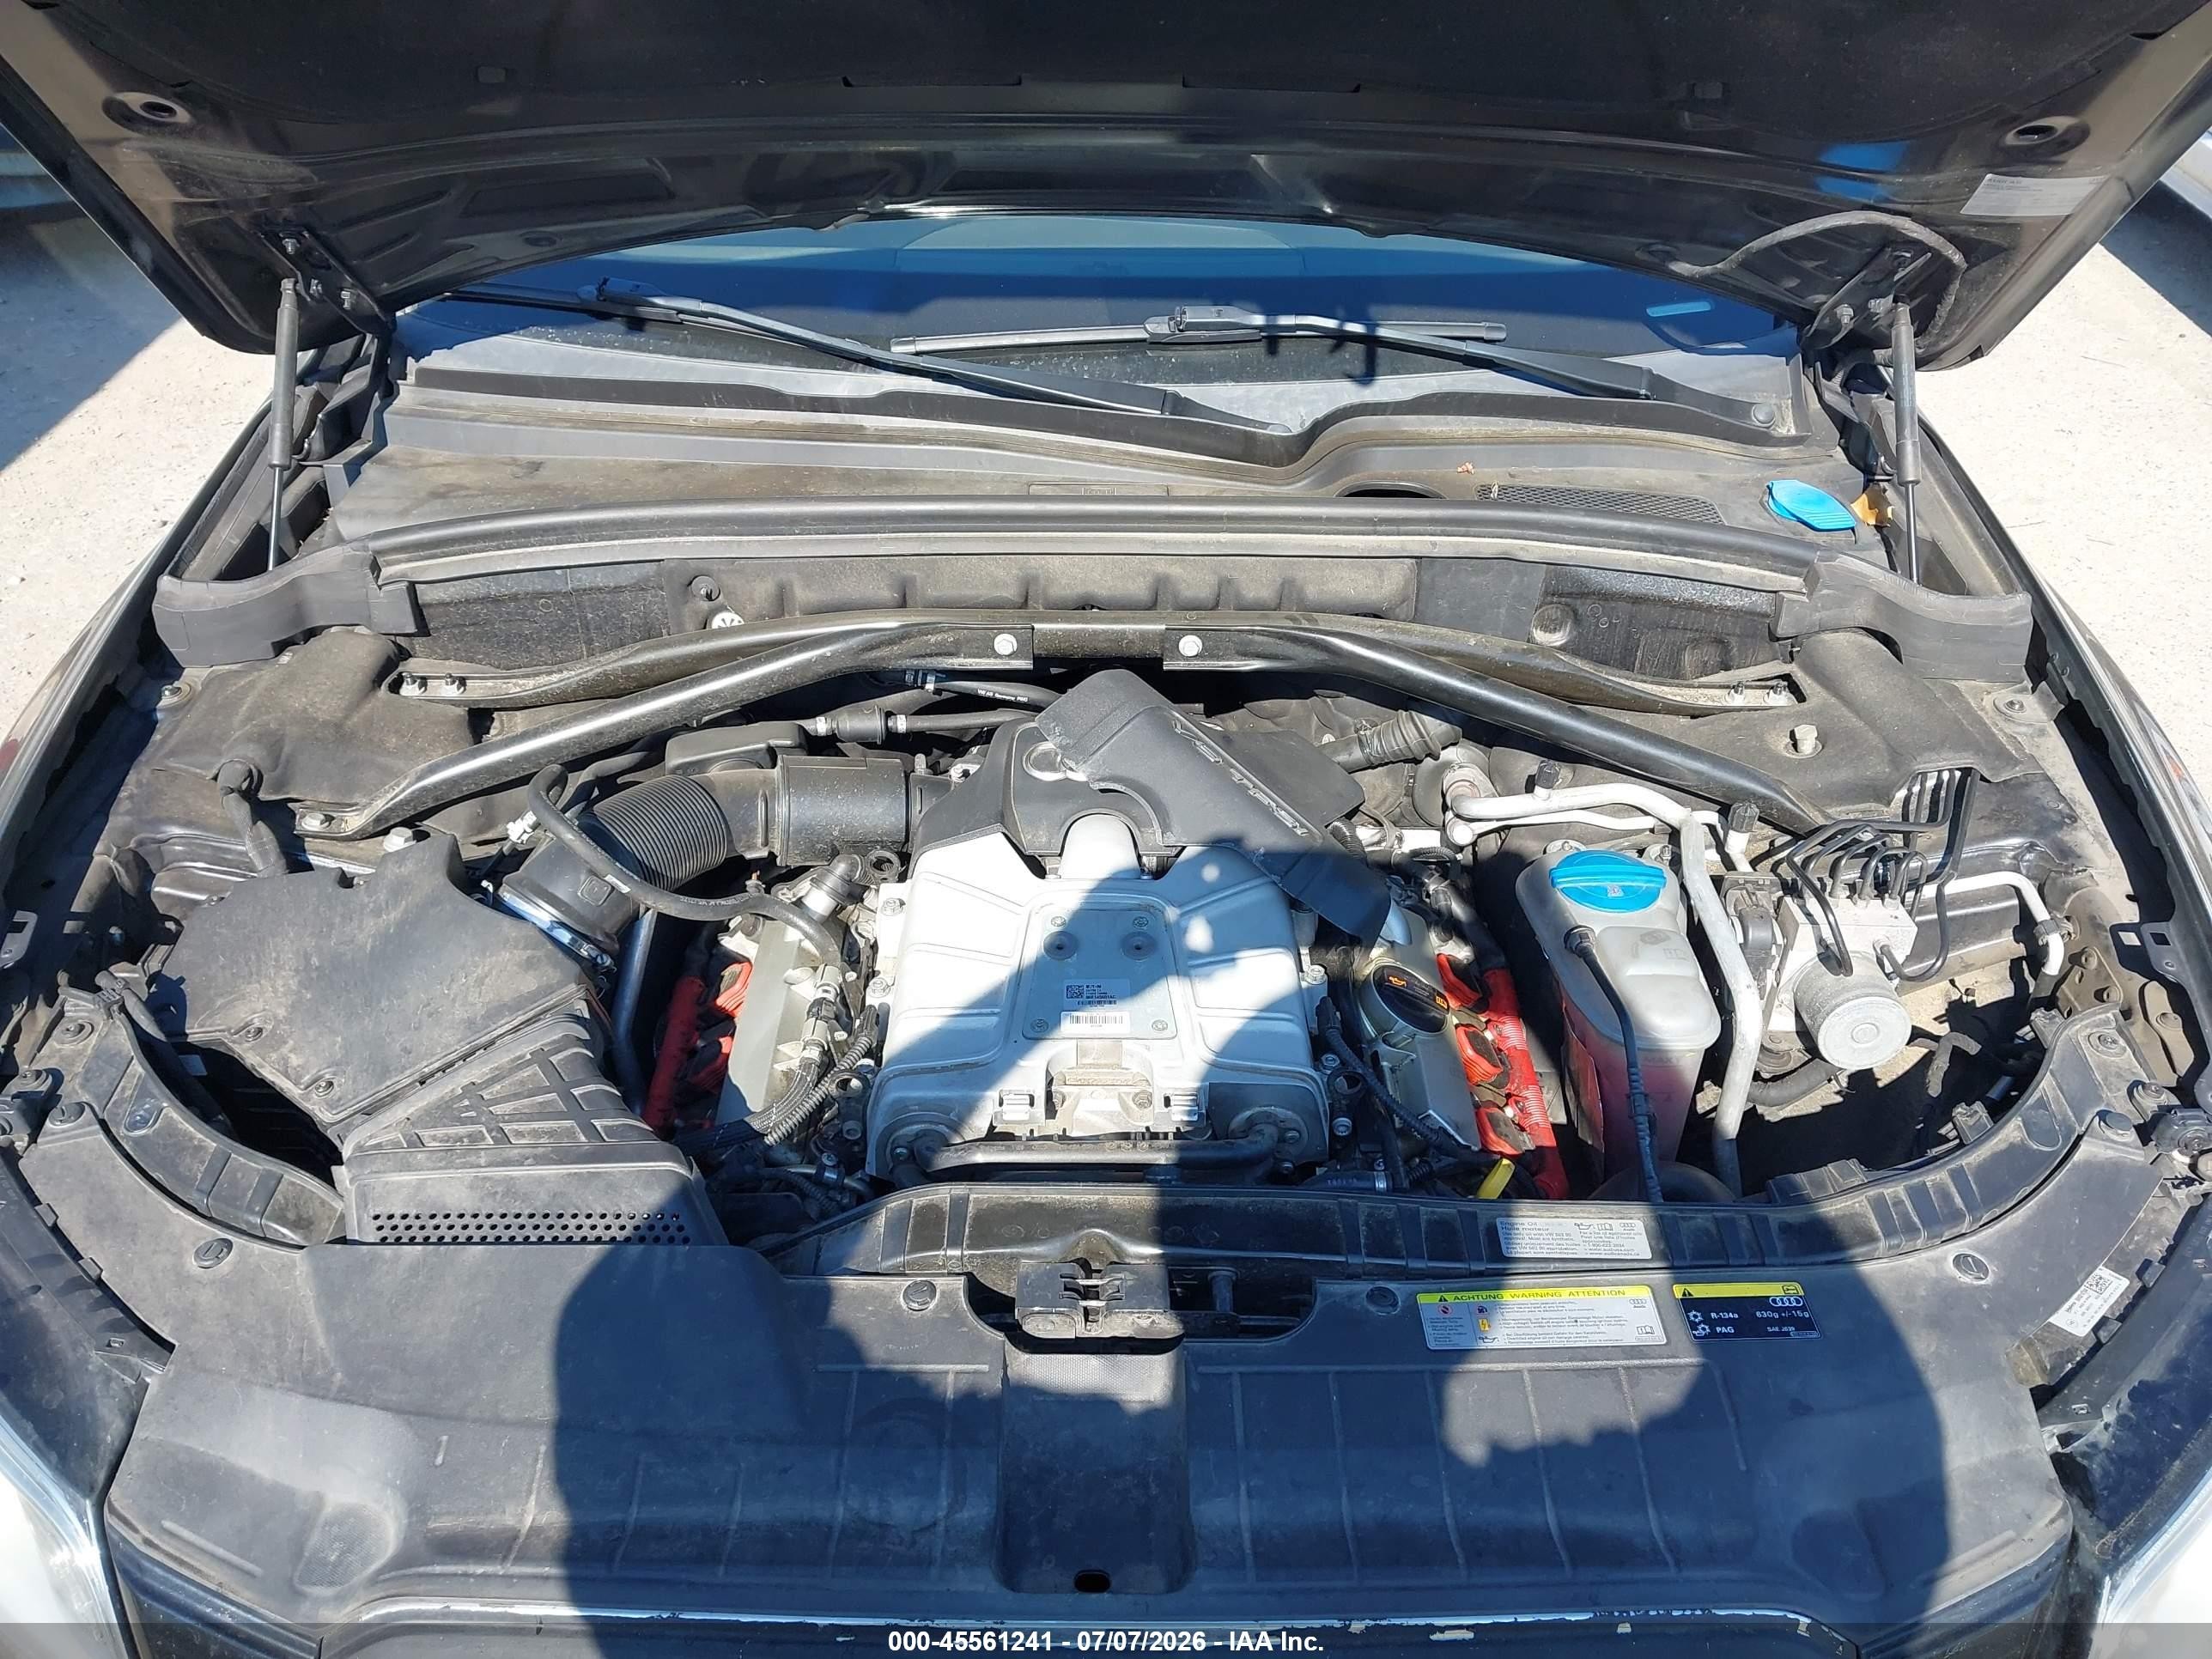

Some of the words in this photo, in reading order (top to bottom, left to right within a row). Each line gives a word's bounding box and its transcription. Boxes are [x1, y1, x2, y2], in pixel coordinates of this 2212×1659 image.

[1453, 1293, 1504, 1302] ACHTUNG
[1510, 1291, 1562, 1299] WARNING
[1568, 1289, 1626, 1297] ATTENTION
[1755, 1310, 1779, 1320] 630g
